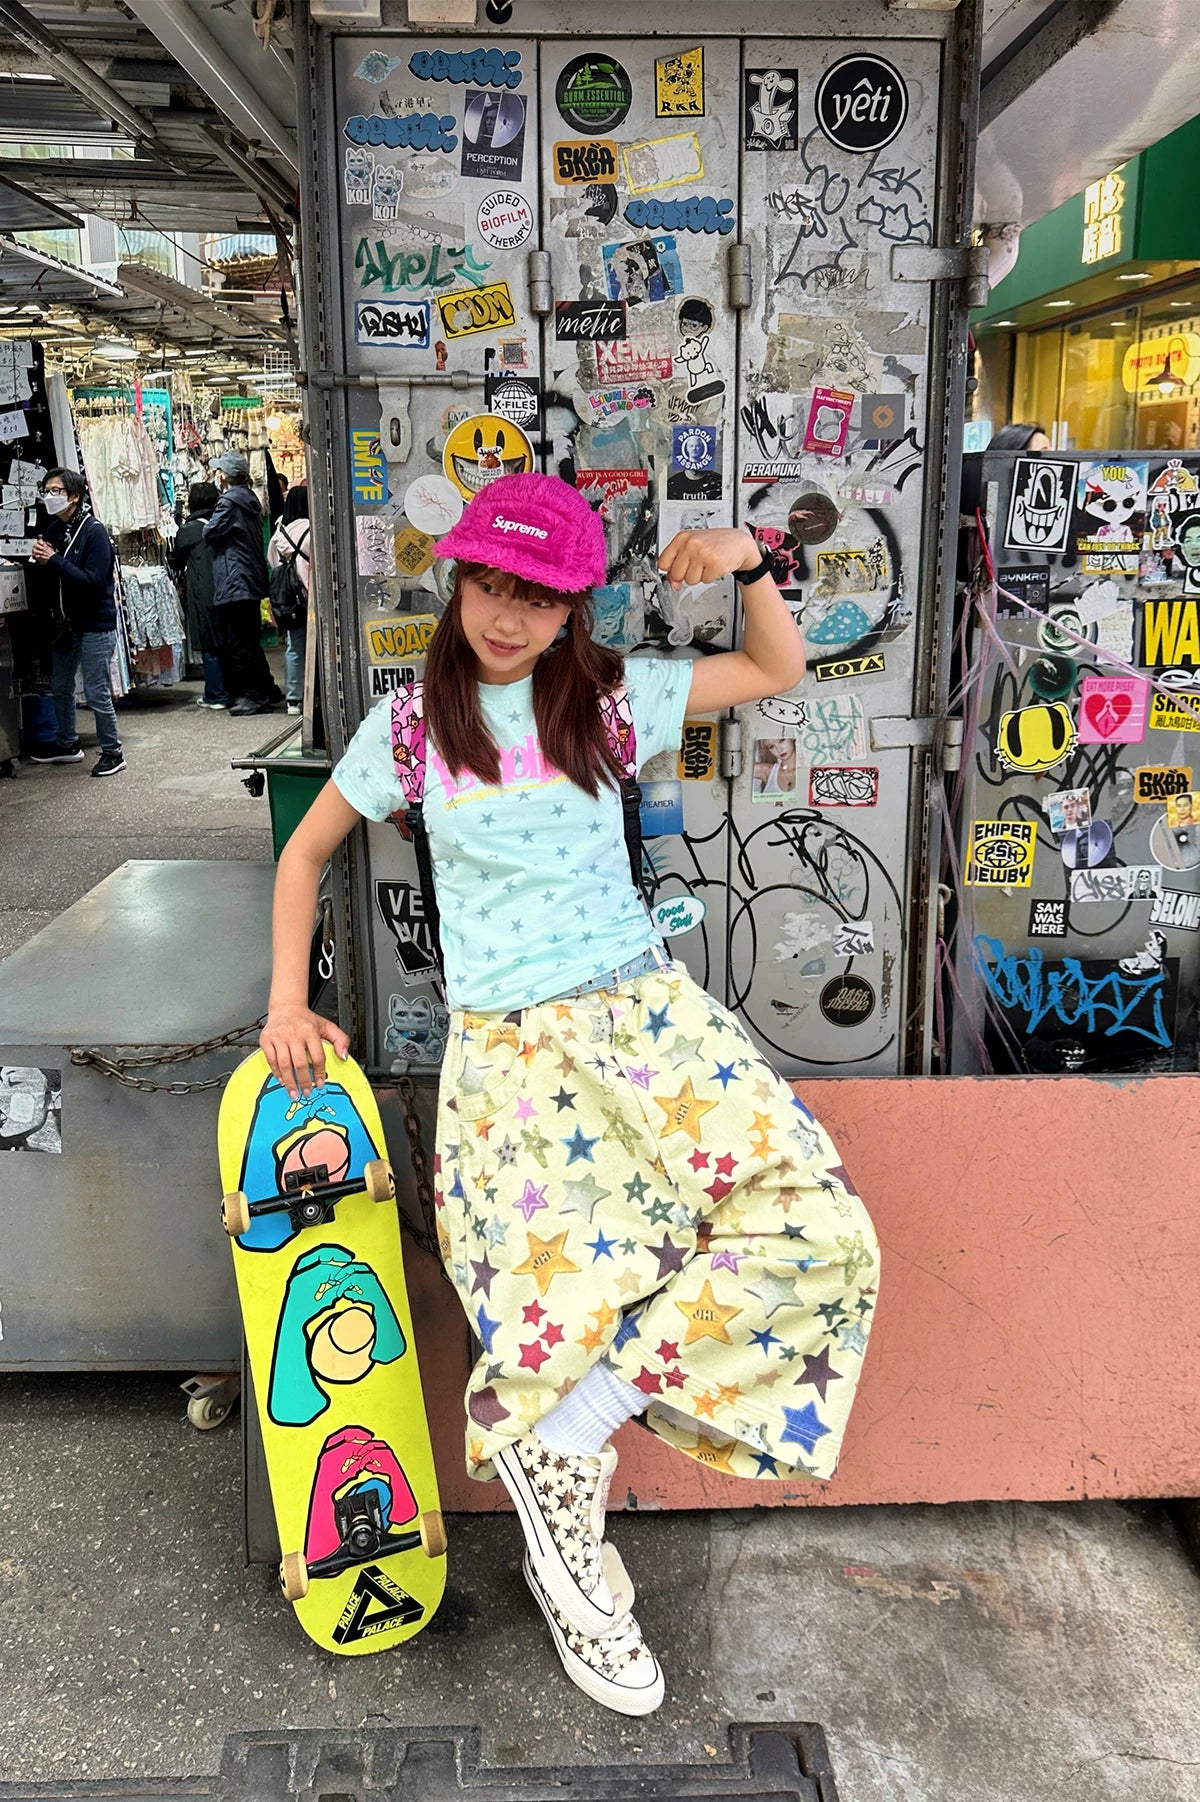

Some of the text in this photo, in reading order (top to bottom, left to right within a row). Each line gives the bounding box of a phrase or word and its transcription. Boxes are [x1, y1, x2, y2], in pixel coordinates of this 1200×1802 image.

[831, 77, 892, 130] yêti
[466, 152, 518, 166] PERCEPTION
[481, 193, 521, 216] GUIDED
[480, 208, 528, 231] BIOFILM
[557, 302, 622, 338] metic
[677, 428, 712, 442] PARDON
[676, 454, 713, 470] ASSANGE
[744, 463, 801, 477] PERAMUNA
[1101, 466, 1127, 481] YOU
[682, 491, 708, 500] truth
[491, 515, 549, 540] Supreme
[818, 655, 883, 680] KOYA
[657, 901, 684, 923] Good
[1034, 913, 1064, 924] WAS
[1036, 902, 1065, 913] SAM
[1031, 923, 1065, 935] HERE
[373, 1574, 410, 1601] PALACE
[338, 1591, 361, 1630] PALACE
[361, 1615, 405, 1638] PALACE
